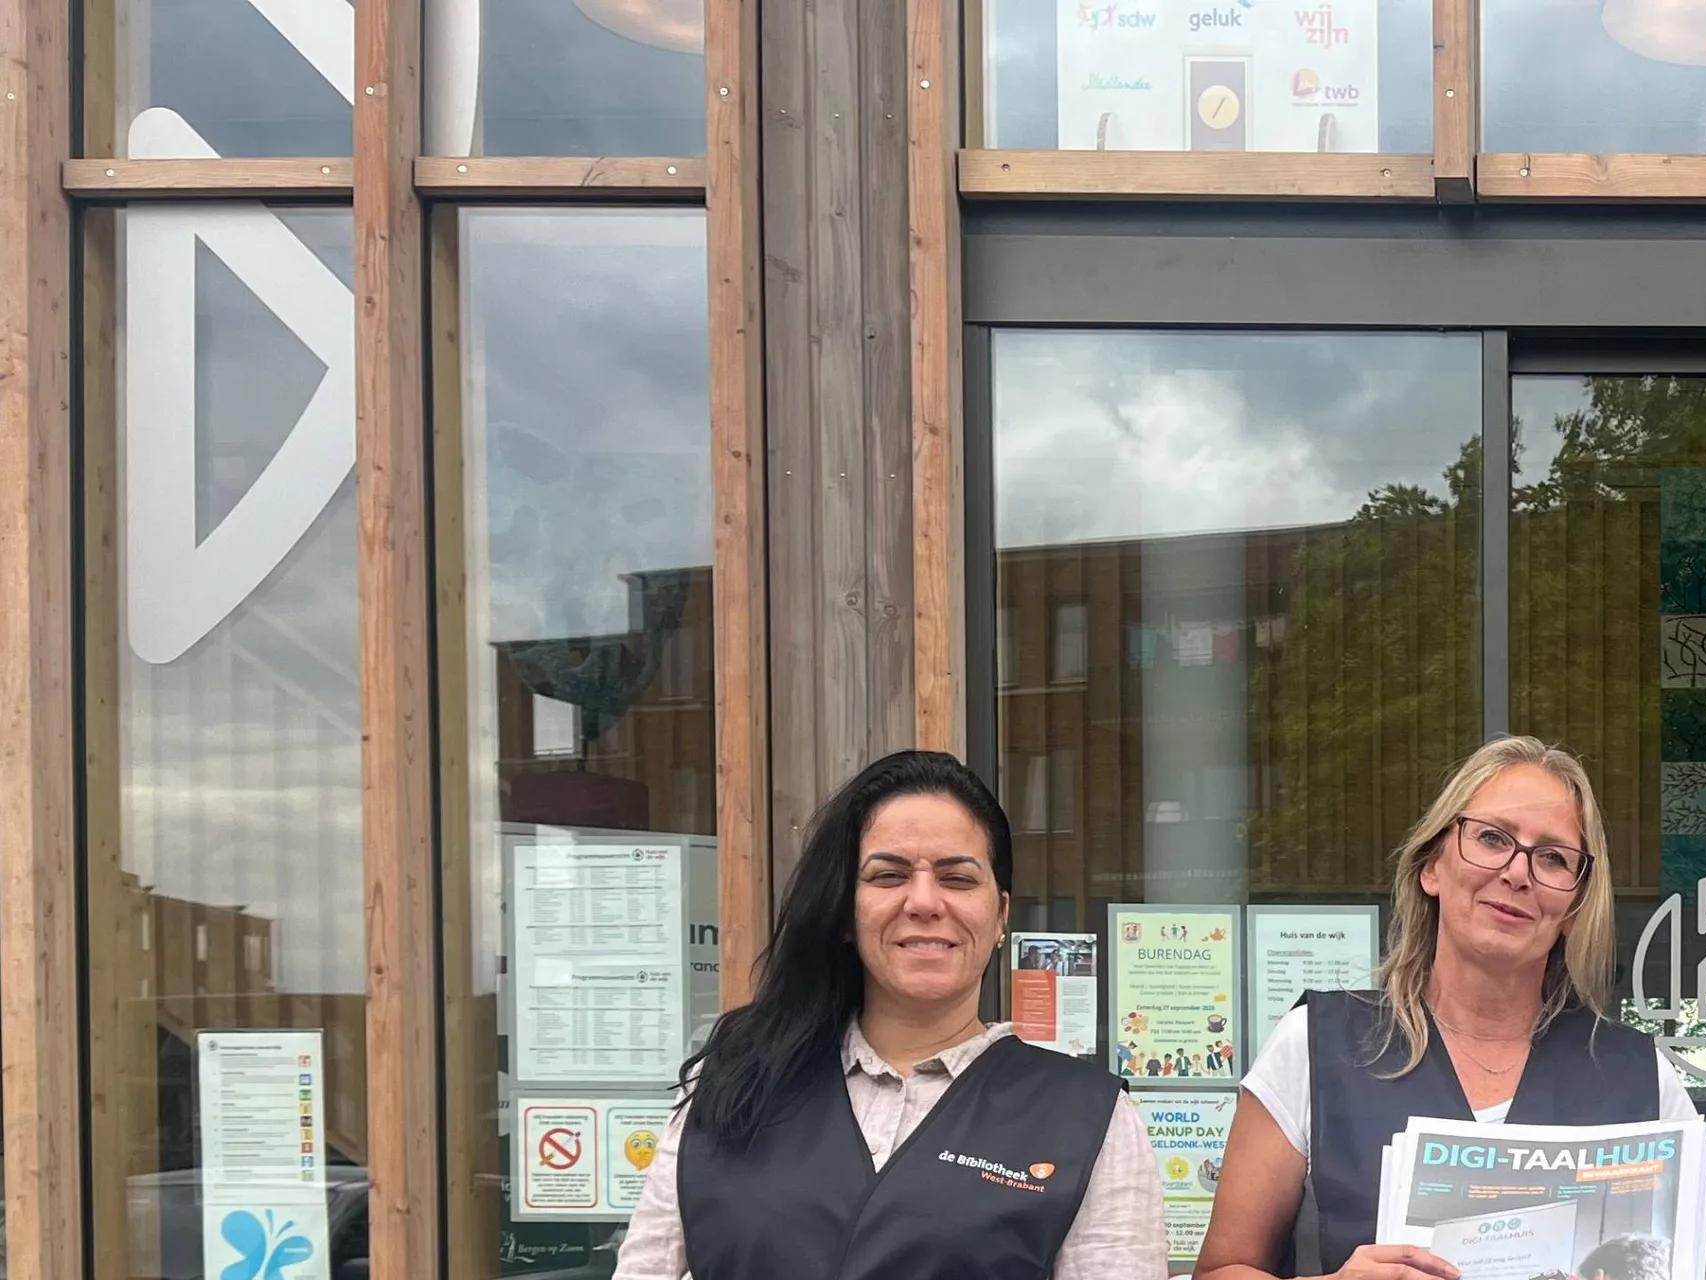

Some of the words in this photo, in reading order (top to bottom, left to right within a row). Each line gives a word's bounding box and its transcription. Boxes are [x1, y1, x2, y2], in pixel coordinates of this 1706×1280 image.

[1189, 8, 1241, 31] geluk
[1324, 84, 1360, 99] twb
[1280, 931, 1298, 939] Huis
[1316, 931, 1326, 939] de
[1328, 931, 1346, 940] wijk
[1138, 948, 1211, 960] BURENDAG
[1152, 1112, 1200, 1123] WORLD
[1147, 1126, 1192, 1137] EANUP
[1196, 1127, 1224, 1137] DAY
[1151, 1140, 1227, 1149] GELDONK-WES
[1422, 1138, 1676, 1171] DIGI-TAALHUIS
[938, 1150, 956, 1163] de
[957, 1154, 1029, 1181] Bibliotheek
[980, 1170, 1045, 1193] West-Brabant
